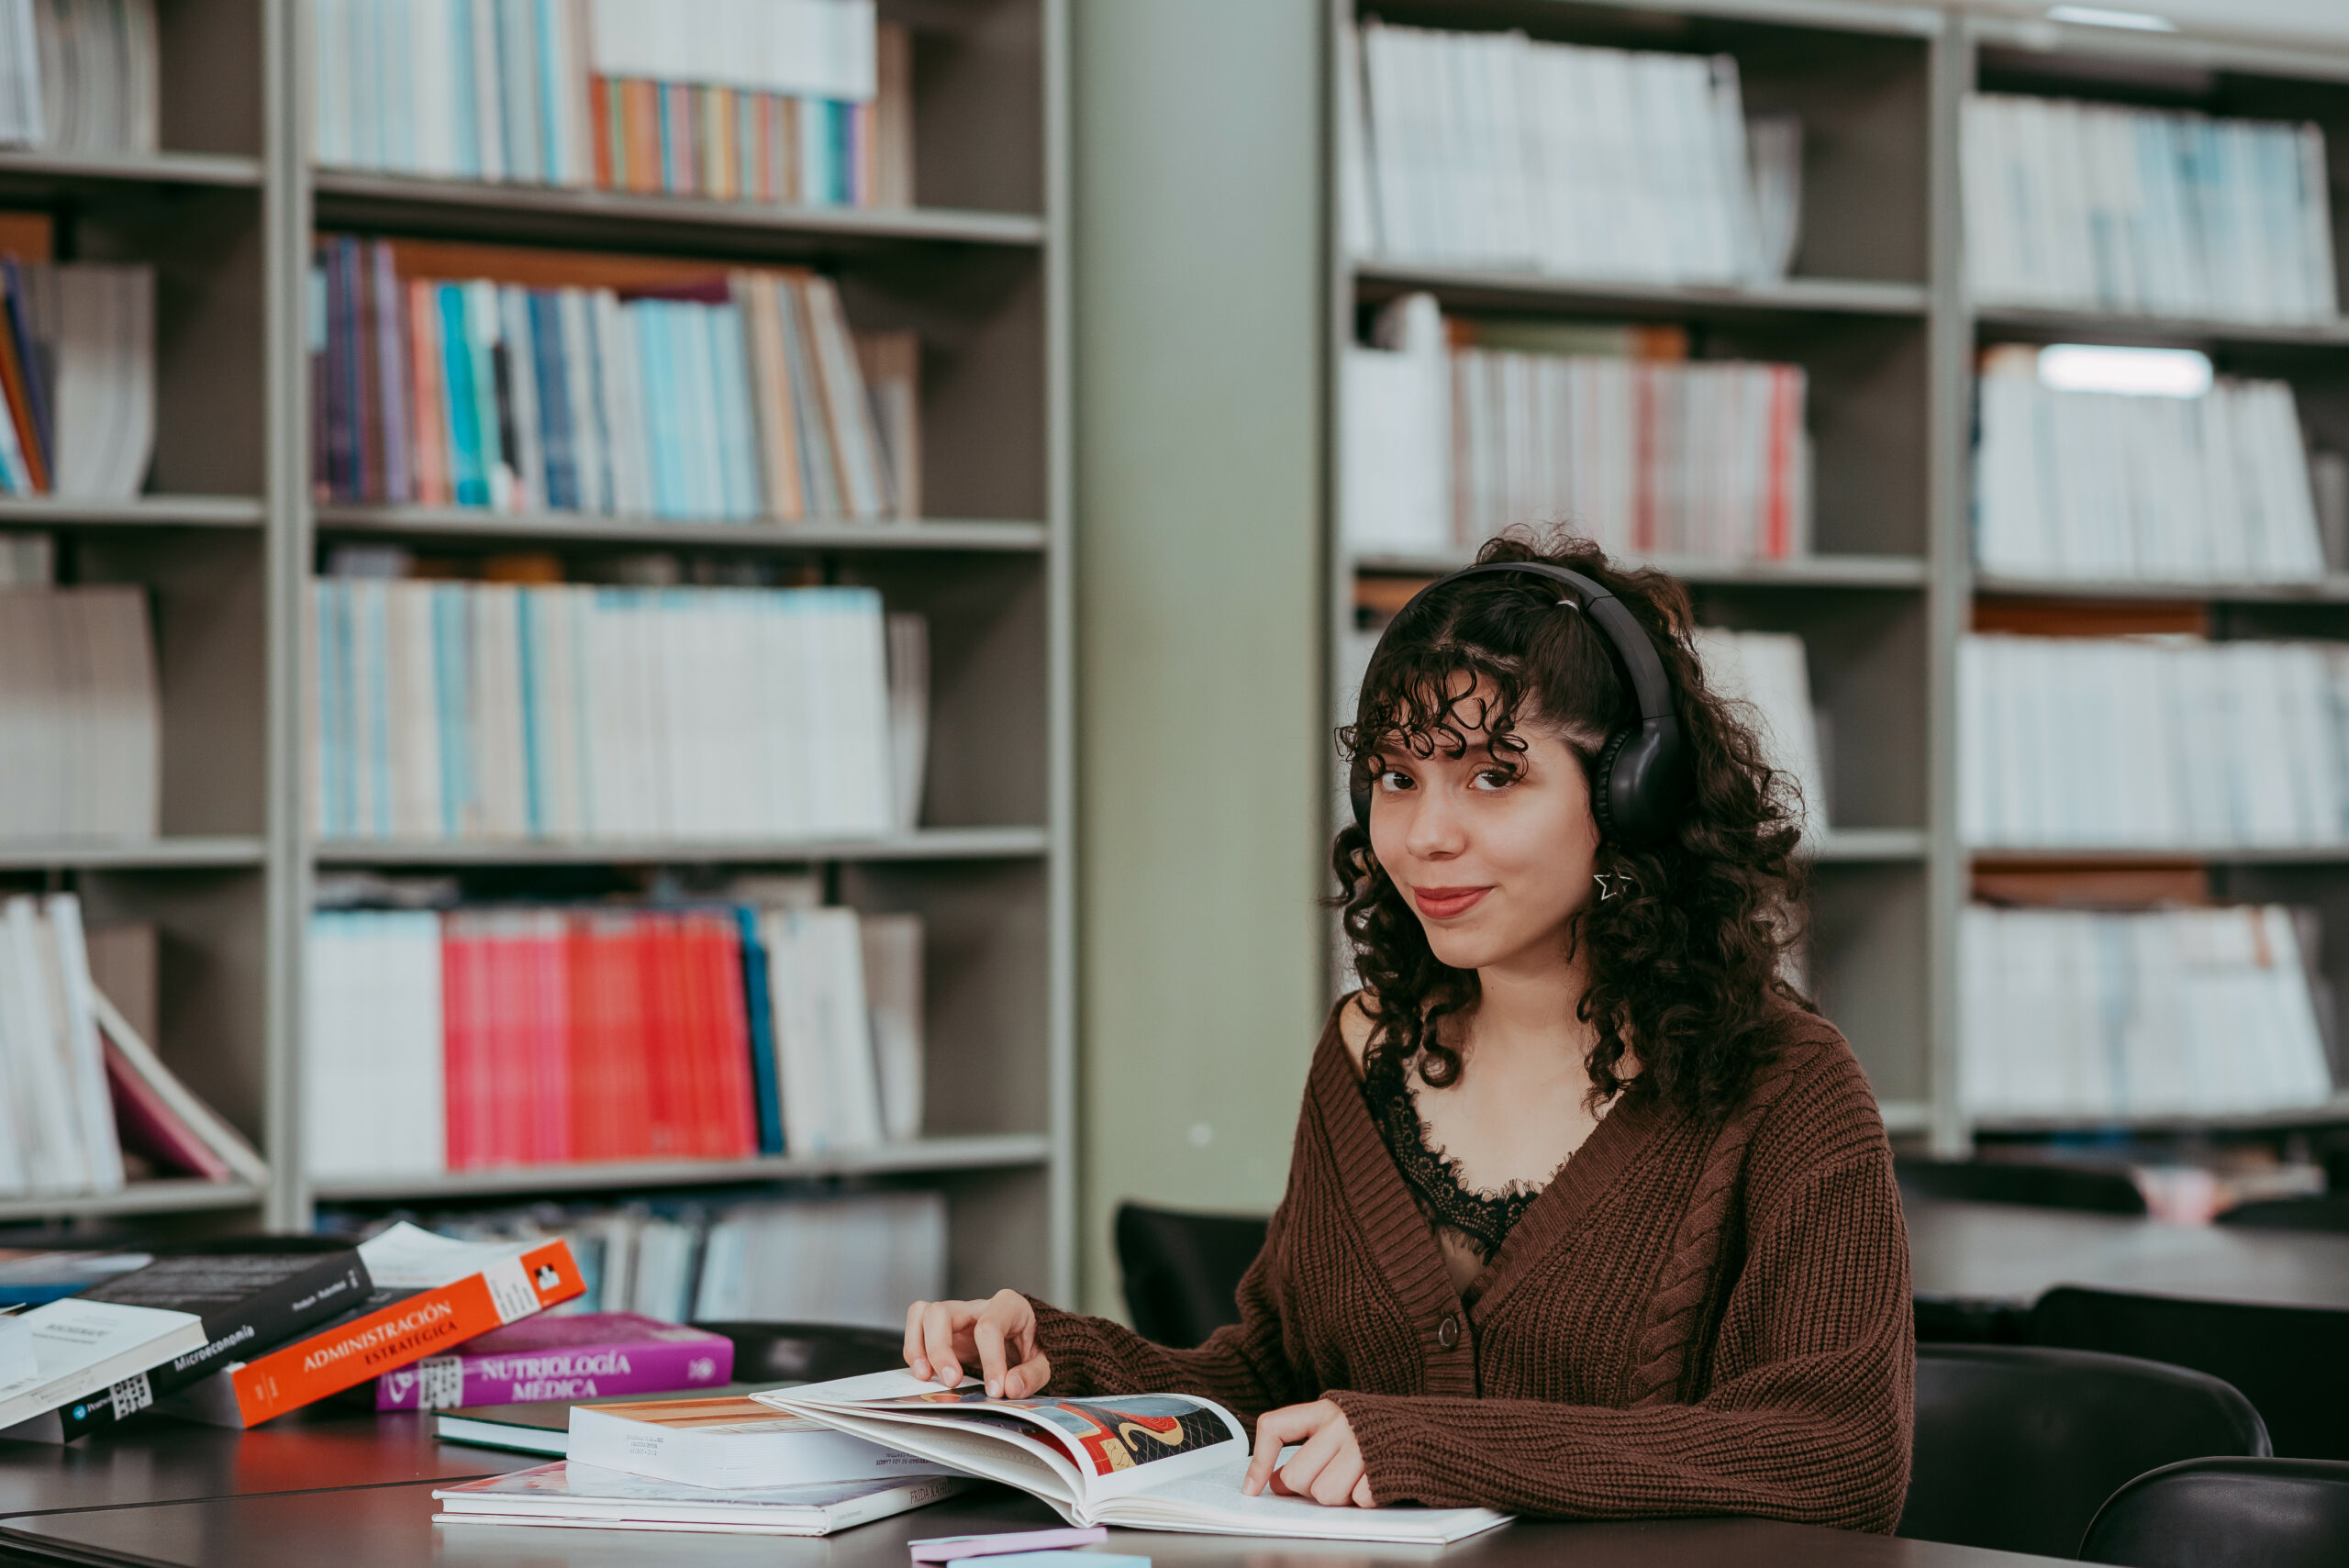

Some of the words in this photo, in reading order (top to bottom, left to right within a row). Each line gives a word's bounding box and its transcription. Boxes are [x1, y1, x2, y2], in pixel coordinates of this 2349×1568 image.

[174, 1324, 255, 1373] Microeconomía
[304, 1300, 452, 1373] ADMINISTRACIÓN
[481, 1349, 631, 1381] NUTRIOLOGÍA
[512, 1376, 597, 1401] MÉDICA
[910, 1487, 930, 1504] FRIDA
[930, 1481, 953, 1498] KAHLO
